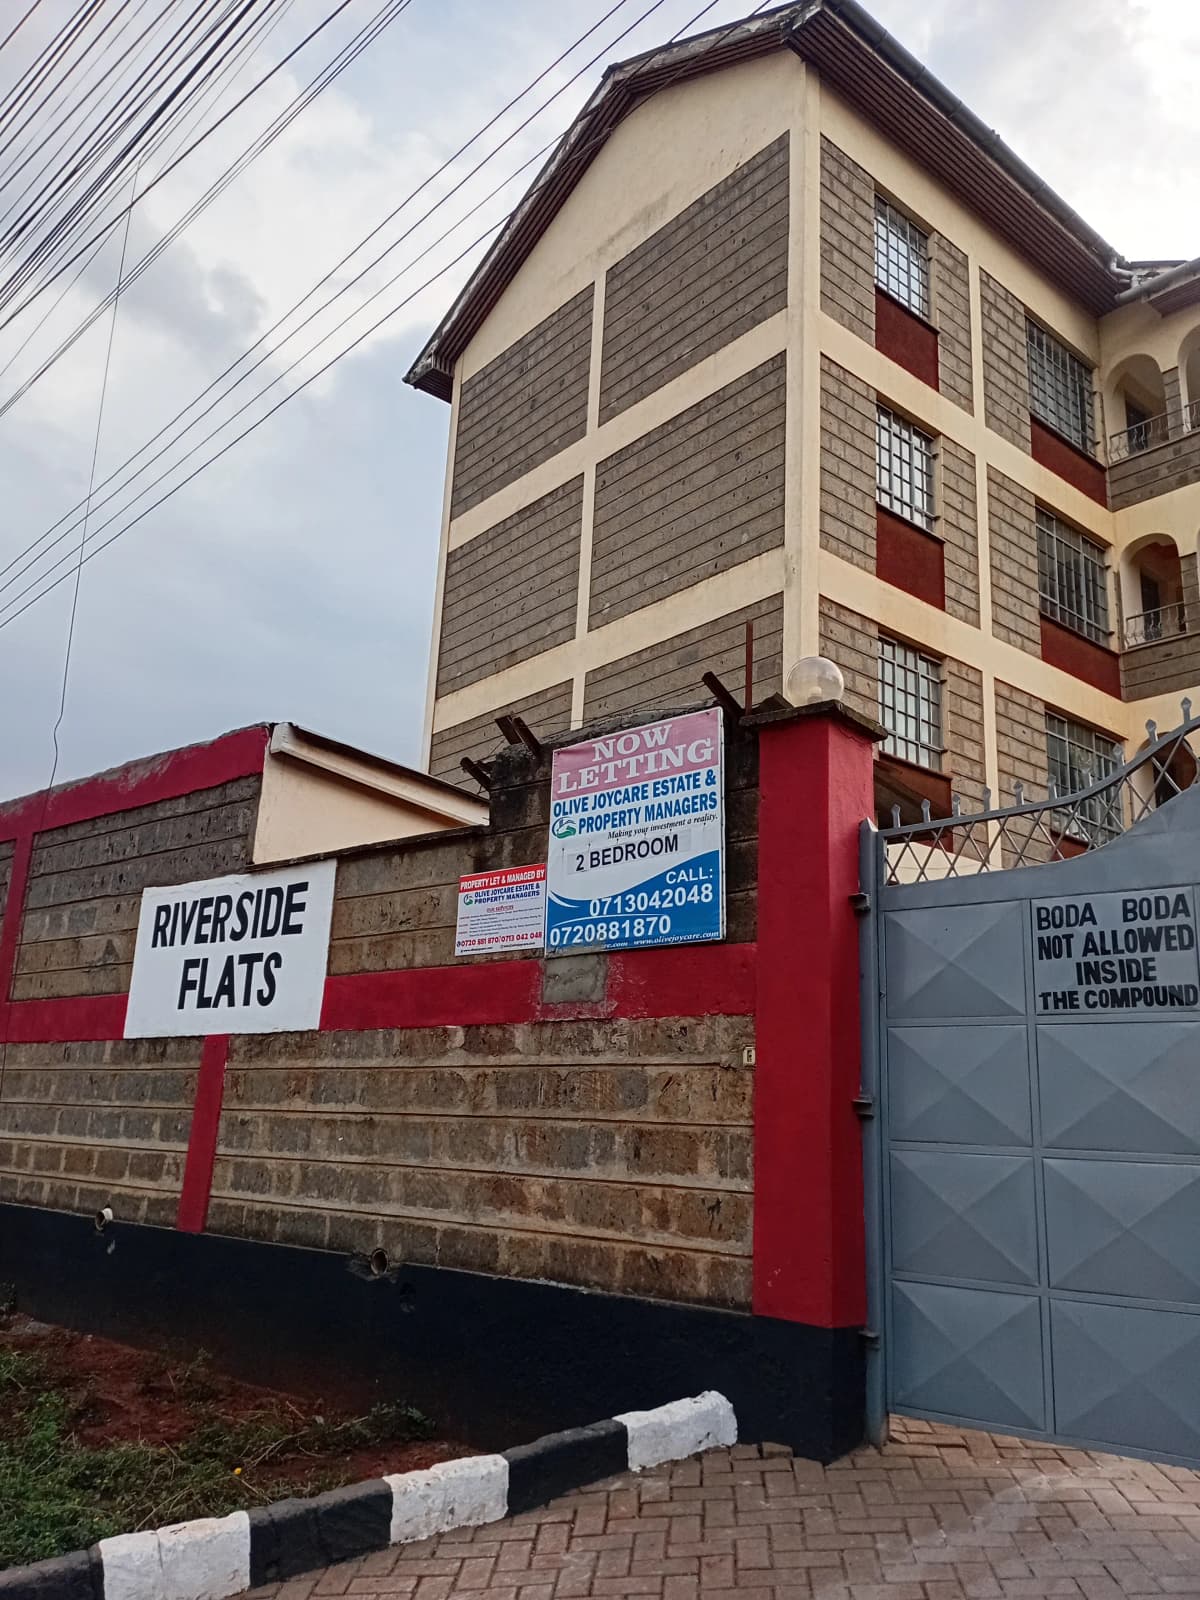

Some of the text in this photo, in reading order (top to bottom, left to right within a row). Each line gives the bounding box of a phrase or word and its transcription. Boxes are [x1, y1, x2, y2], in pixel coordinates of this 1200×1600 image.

[591, 724, 672, 762] NOW
[557, 738, 714, 794] LETTING
[553, 769, 717, 818] OLIVE JOYCARE ESTATE &
[578, 791, 718, 835] PROPERTY MANAGERS
[607, 829, 633, 841] Making
[633, 826, 649, 836] your
[650, 819, 686, 832] investment
[693, 813, 718, 824] reality.
[575, 834, 678, 872] 2 BEDROOM
[460, 877, 489, 891] PROPERTY
[490, 876, 500, 886] LET
[507, 871, 536, 884] MANAGED
[536, 869, 545, 879] BY
[474, 889, 490, 898] OLIVE
[491, 886, 514, 896] JOYCARE
[516, 884, 534, 892] ESTATE
[665, 866, 713, 885] CALL:
[474, 895, 504, 904] PROPERTY
[506, 890, 540, 900] MANAGERS
[589, 883, 713, 917] 0713042048
[1036, 893, 1191, 931] BODA BODA
[151, 881, 309, 948] RIVERSIDE
[549, 914, 671, 946] 0720881870
[633, 931, 719, 946] www.olivejoycare.com
[1037, 923, 1195, 960] NOT ALLOWED
[177, 951, 282, 1010] FLATS
[1075, 957, 1157, 986] INSIDE
[1038, 984, 1199, 1010] THE COMPOUND
